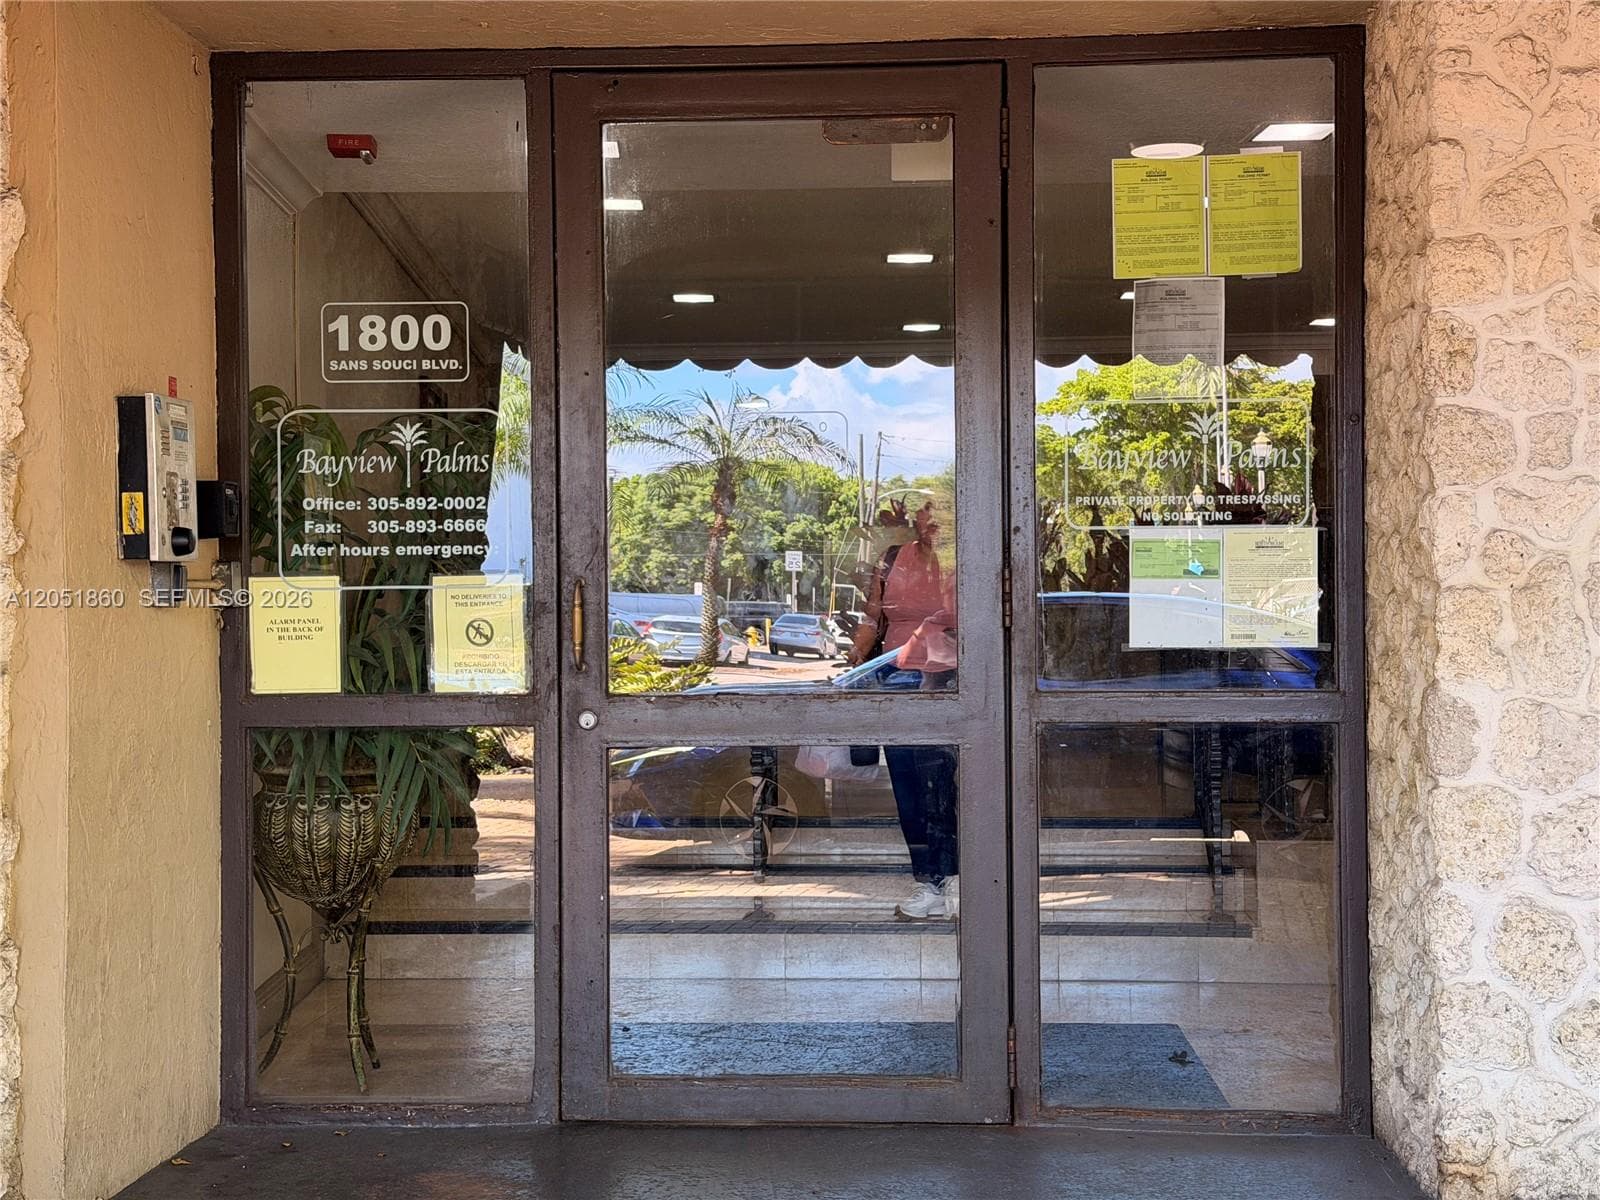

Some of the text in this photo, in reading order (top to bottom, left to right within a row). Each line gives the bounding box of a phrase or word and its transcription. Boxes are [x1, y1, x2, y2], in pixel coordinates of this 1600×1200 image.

[327, 314, 451, 352] 1800
[329, 359, 463, 371] SANS SOUCI BLVD.
[296, 441, 490, 487] Bayview Palms
[1077, 442, 1193, 478] Bayview
[302, 496, 487, 511] Office: 305-892-0002
[1075, 495, 1124, 506] PRIVATE
[1218, 494, 1302, 505] TRESPASSING
[1142, 511, 1162, 521] NO
[305, 519, 487, 534] Fax: 305-893-6666
[290, 543, 334, 557] After
[339, 543, 390, 557] hours
[297, 617, 321, 625] PANEL
